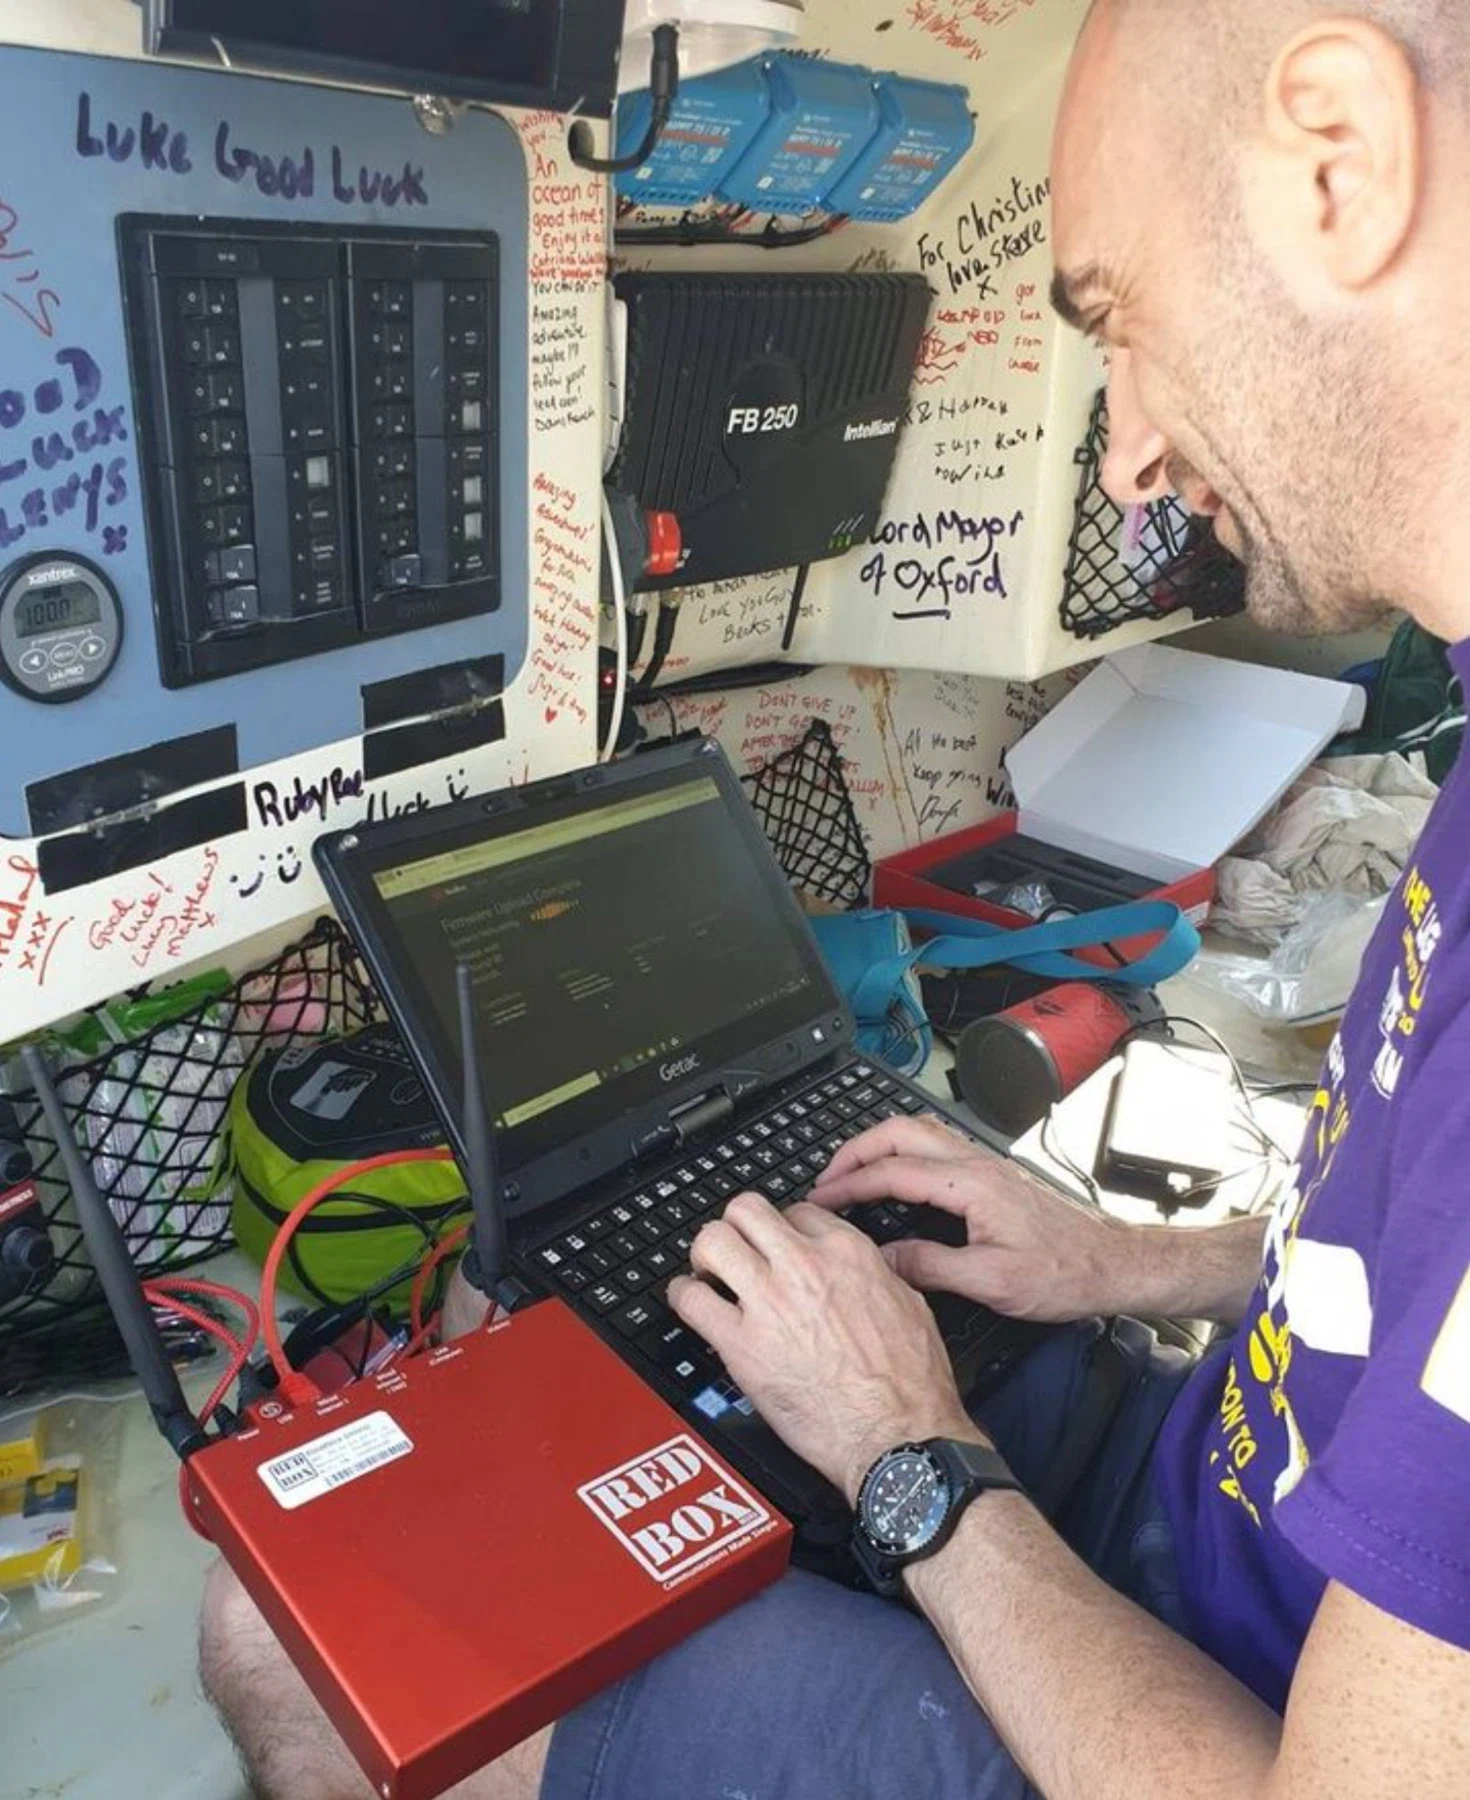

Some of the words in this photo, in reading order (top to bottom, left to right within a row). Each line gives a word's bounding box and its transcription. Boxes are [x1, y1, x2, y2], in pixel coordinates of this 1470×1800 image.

[916, 233, 945, 271] For
[956, 176, 1051, 255] Christin
[726, 406, 761, 435] FB
[760, 403, 799, 432] 250
[843, 417, 899, 442] Intellian
[936, 509, 1024, 566] Mayor
[893, 551, 1008, 606] Oxford
[790, 713, 813, 729] GE
[657, 1052, 702, 1083] Getac
[591, 1446, 703, 1521] RED
[630, 1483, 754, 1567] BOX
